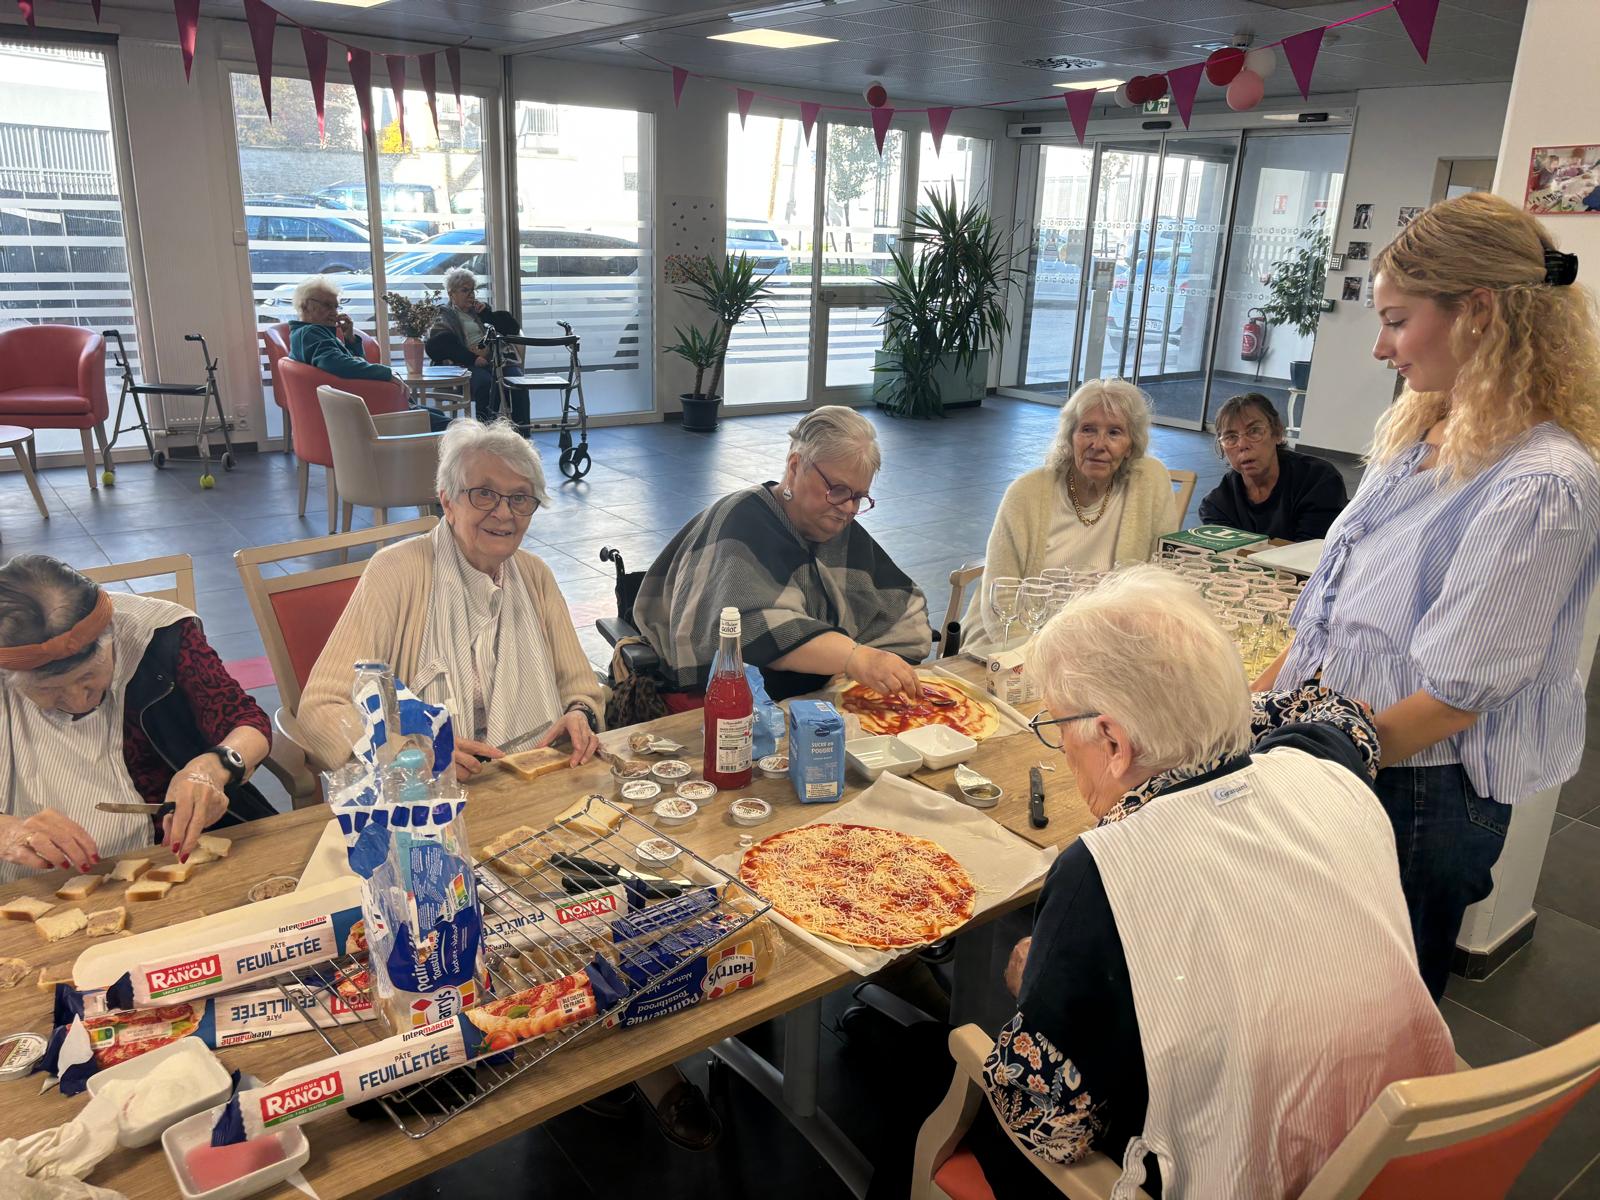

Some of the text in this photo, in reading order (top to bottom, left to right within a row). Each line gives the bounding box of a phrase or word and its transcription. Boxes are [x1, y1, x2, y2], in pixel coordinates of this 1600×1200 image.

[561, 897, 610, 921] RANOU
[482, 911, 545, 940] FEUILLETÉ
[236, 936, 322, 975] FEUILLETÉE
[270, 941, 286, 951] PÂTE
[151, 959, 216, 989] RANOU
[168, 962, 199, 974] MONIQUE
[666, 972, 692, 986] Nature
[637, 990, 689, 1014] Toastbrood
[266, 1013, 282, 1022] PÂTE
[359, 1044, 450, 1091] FEUILLETÉE
[394, 1051, 412, 1062] PÂTE
[267, 1077, 337, 1116] RANOU
[285, 1082, 318, 1096] MONIQUE
